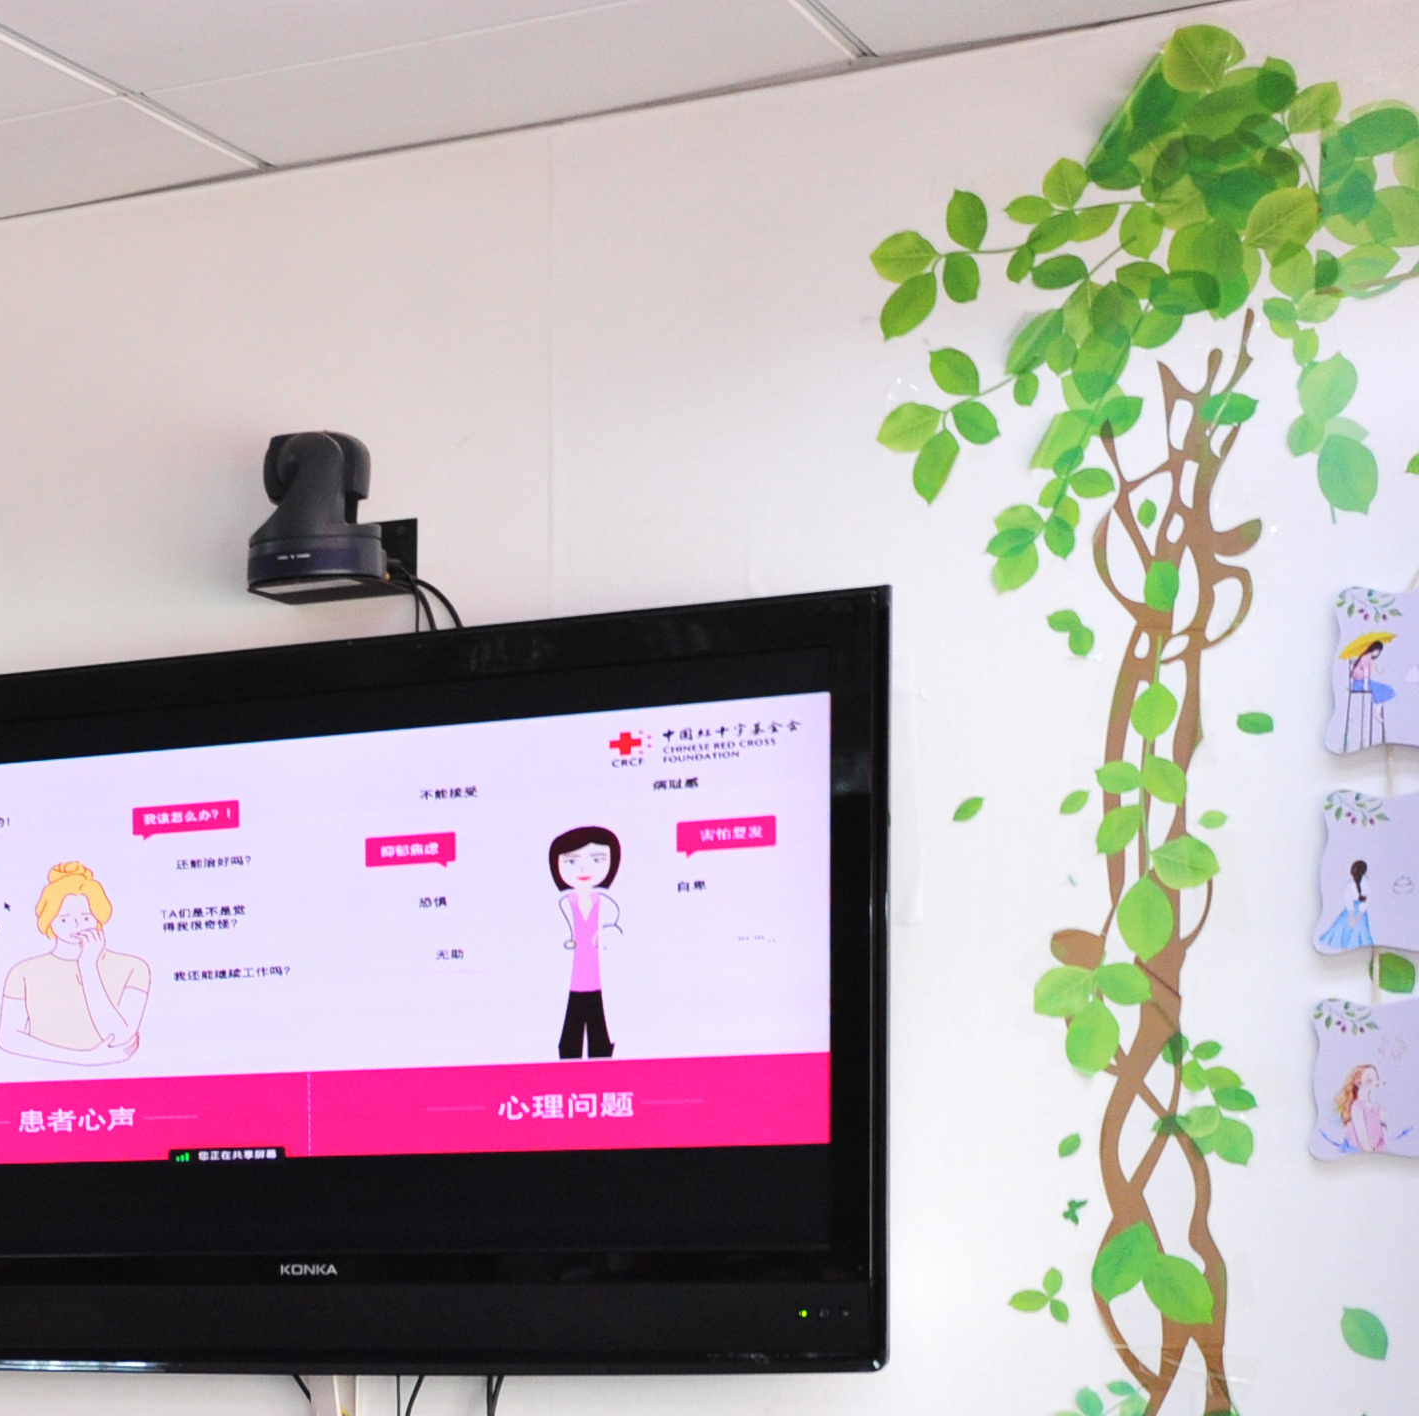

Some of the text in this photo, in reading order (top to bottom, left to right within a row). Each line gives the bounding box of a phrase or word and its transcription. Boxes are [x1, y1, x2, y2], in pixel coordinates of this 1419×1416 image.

[662, 719, 802, 742] 中国红十字基金会
[663, 738, 776, 754] CHINESE RED CROSS
[611, 757, 645, 768] CRCF
[663, 751, 740, 764] FOUNDATION
[419, 786, 478, 801] 不能接受
[676, 880, 707, 893] 自卑
[497, 1091, 634, 1121] 心理问题
[18, 1106, 136, 1134] 患者心声
[280, 1264, 338, 1276] KONKA
